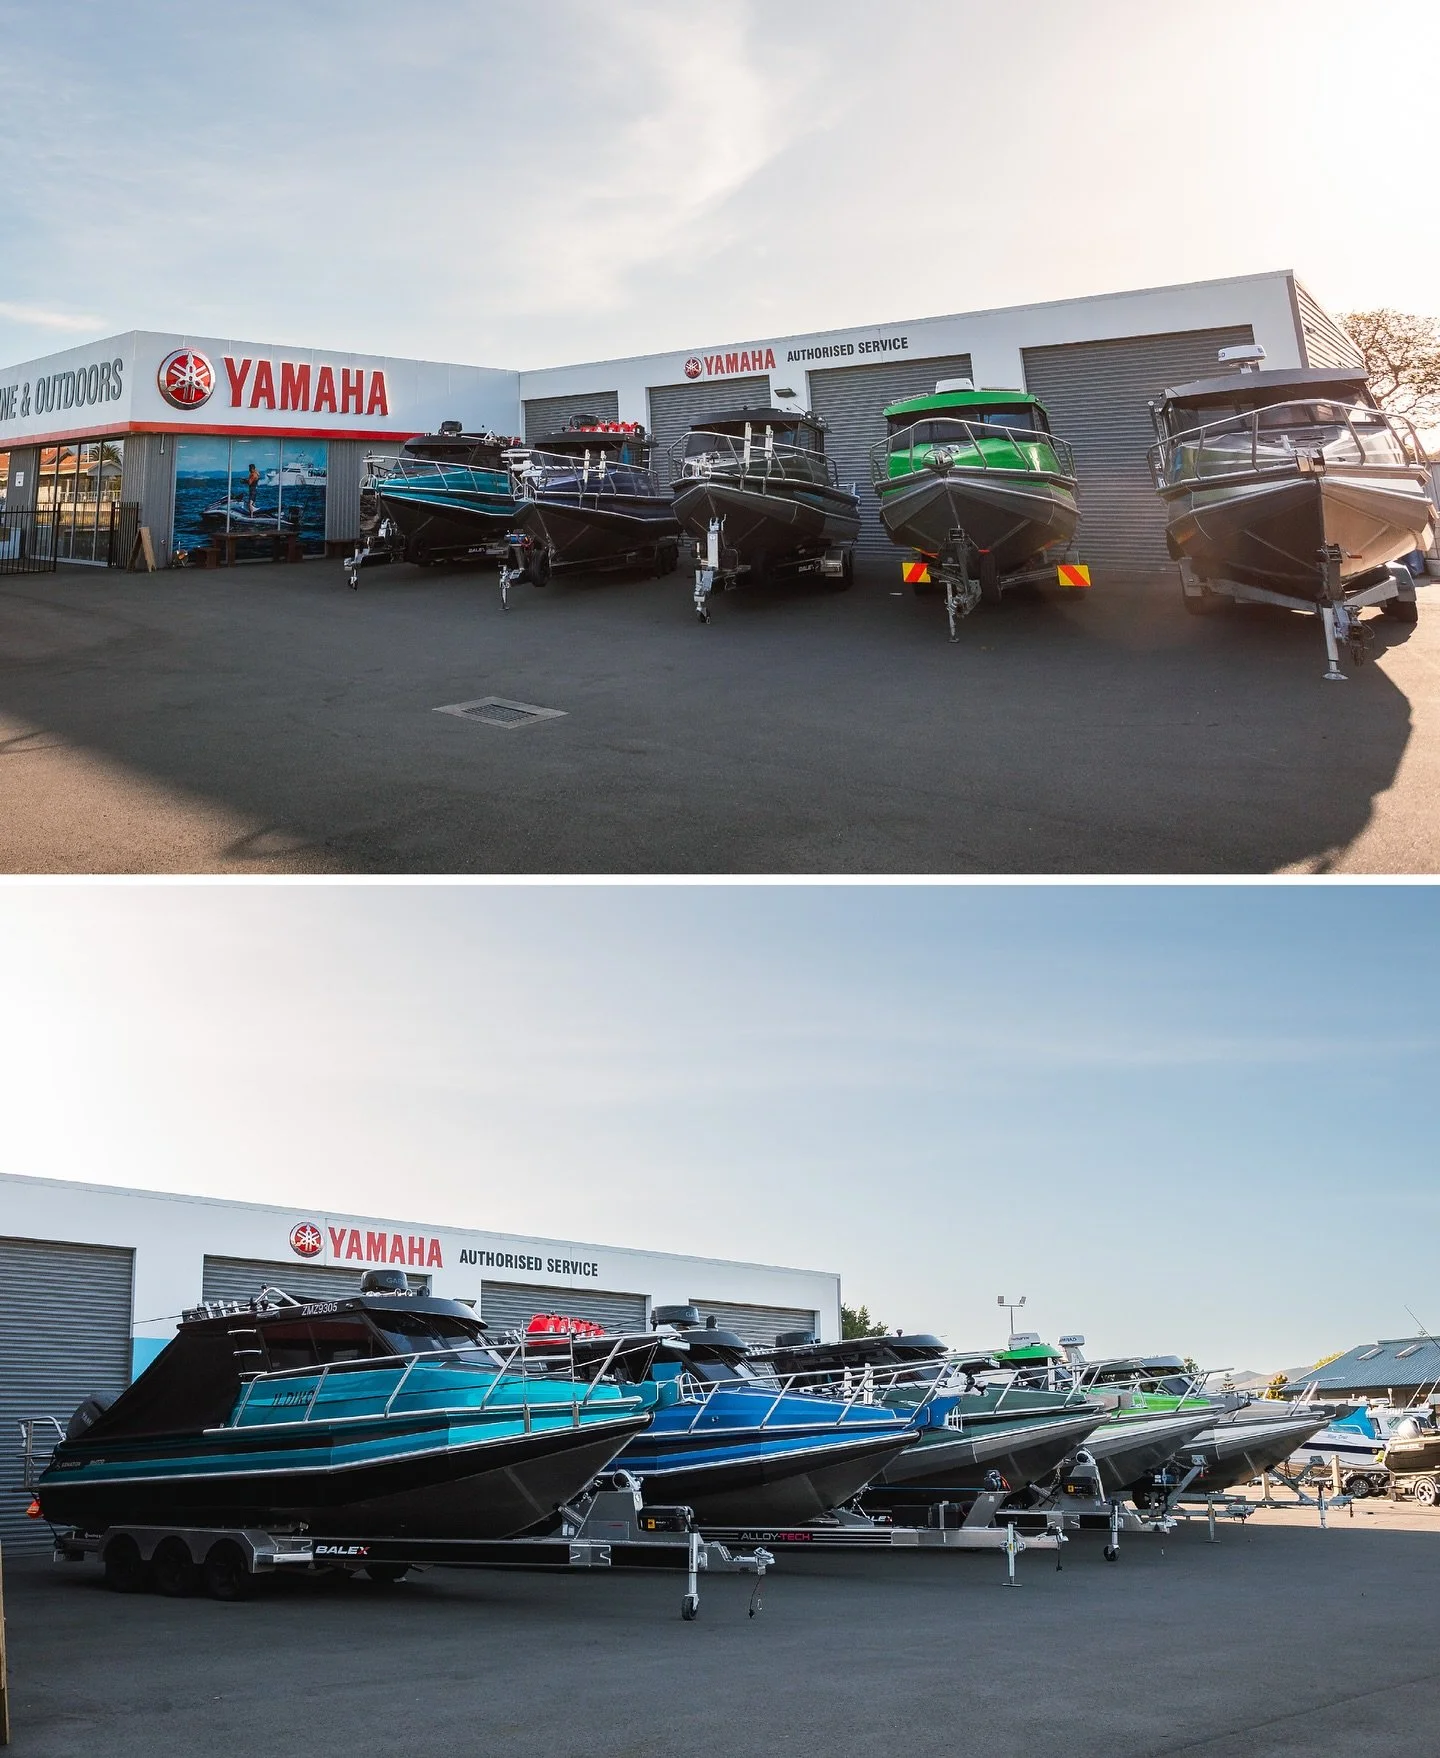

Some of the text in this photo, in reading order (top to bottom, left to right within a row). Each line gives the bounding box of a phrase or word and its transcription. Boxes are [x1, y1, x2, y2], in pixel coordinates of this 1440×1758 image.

[704, 337, 909, 375] YAMAHA AUTHORISED SERVICE
[20, 382, 31, 418] &
[34, 358, 123, 415] OUTDOORS
[223, 357, 389, 417] YAMAHA
[328, 1226, 599, 1277] YAMAHA AUTHORISED SERVICE
[301, 1302, 338, 1316] ZMZ9305
[315, 1545, 371, 1555] BALEX
[740, 1532, 811, 1541] ALLOY-TECH
